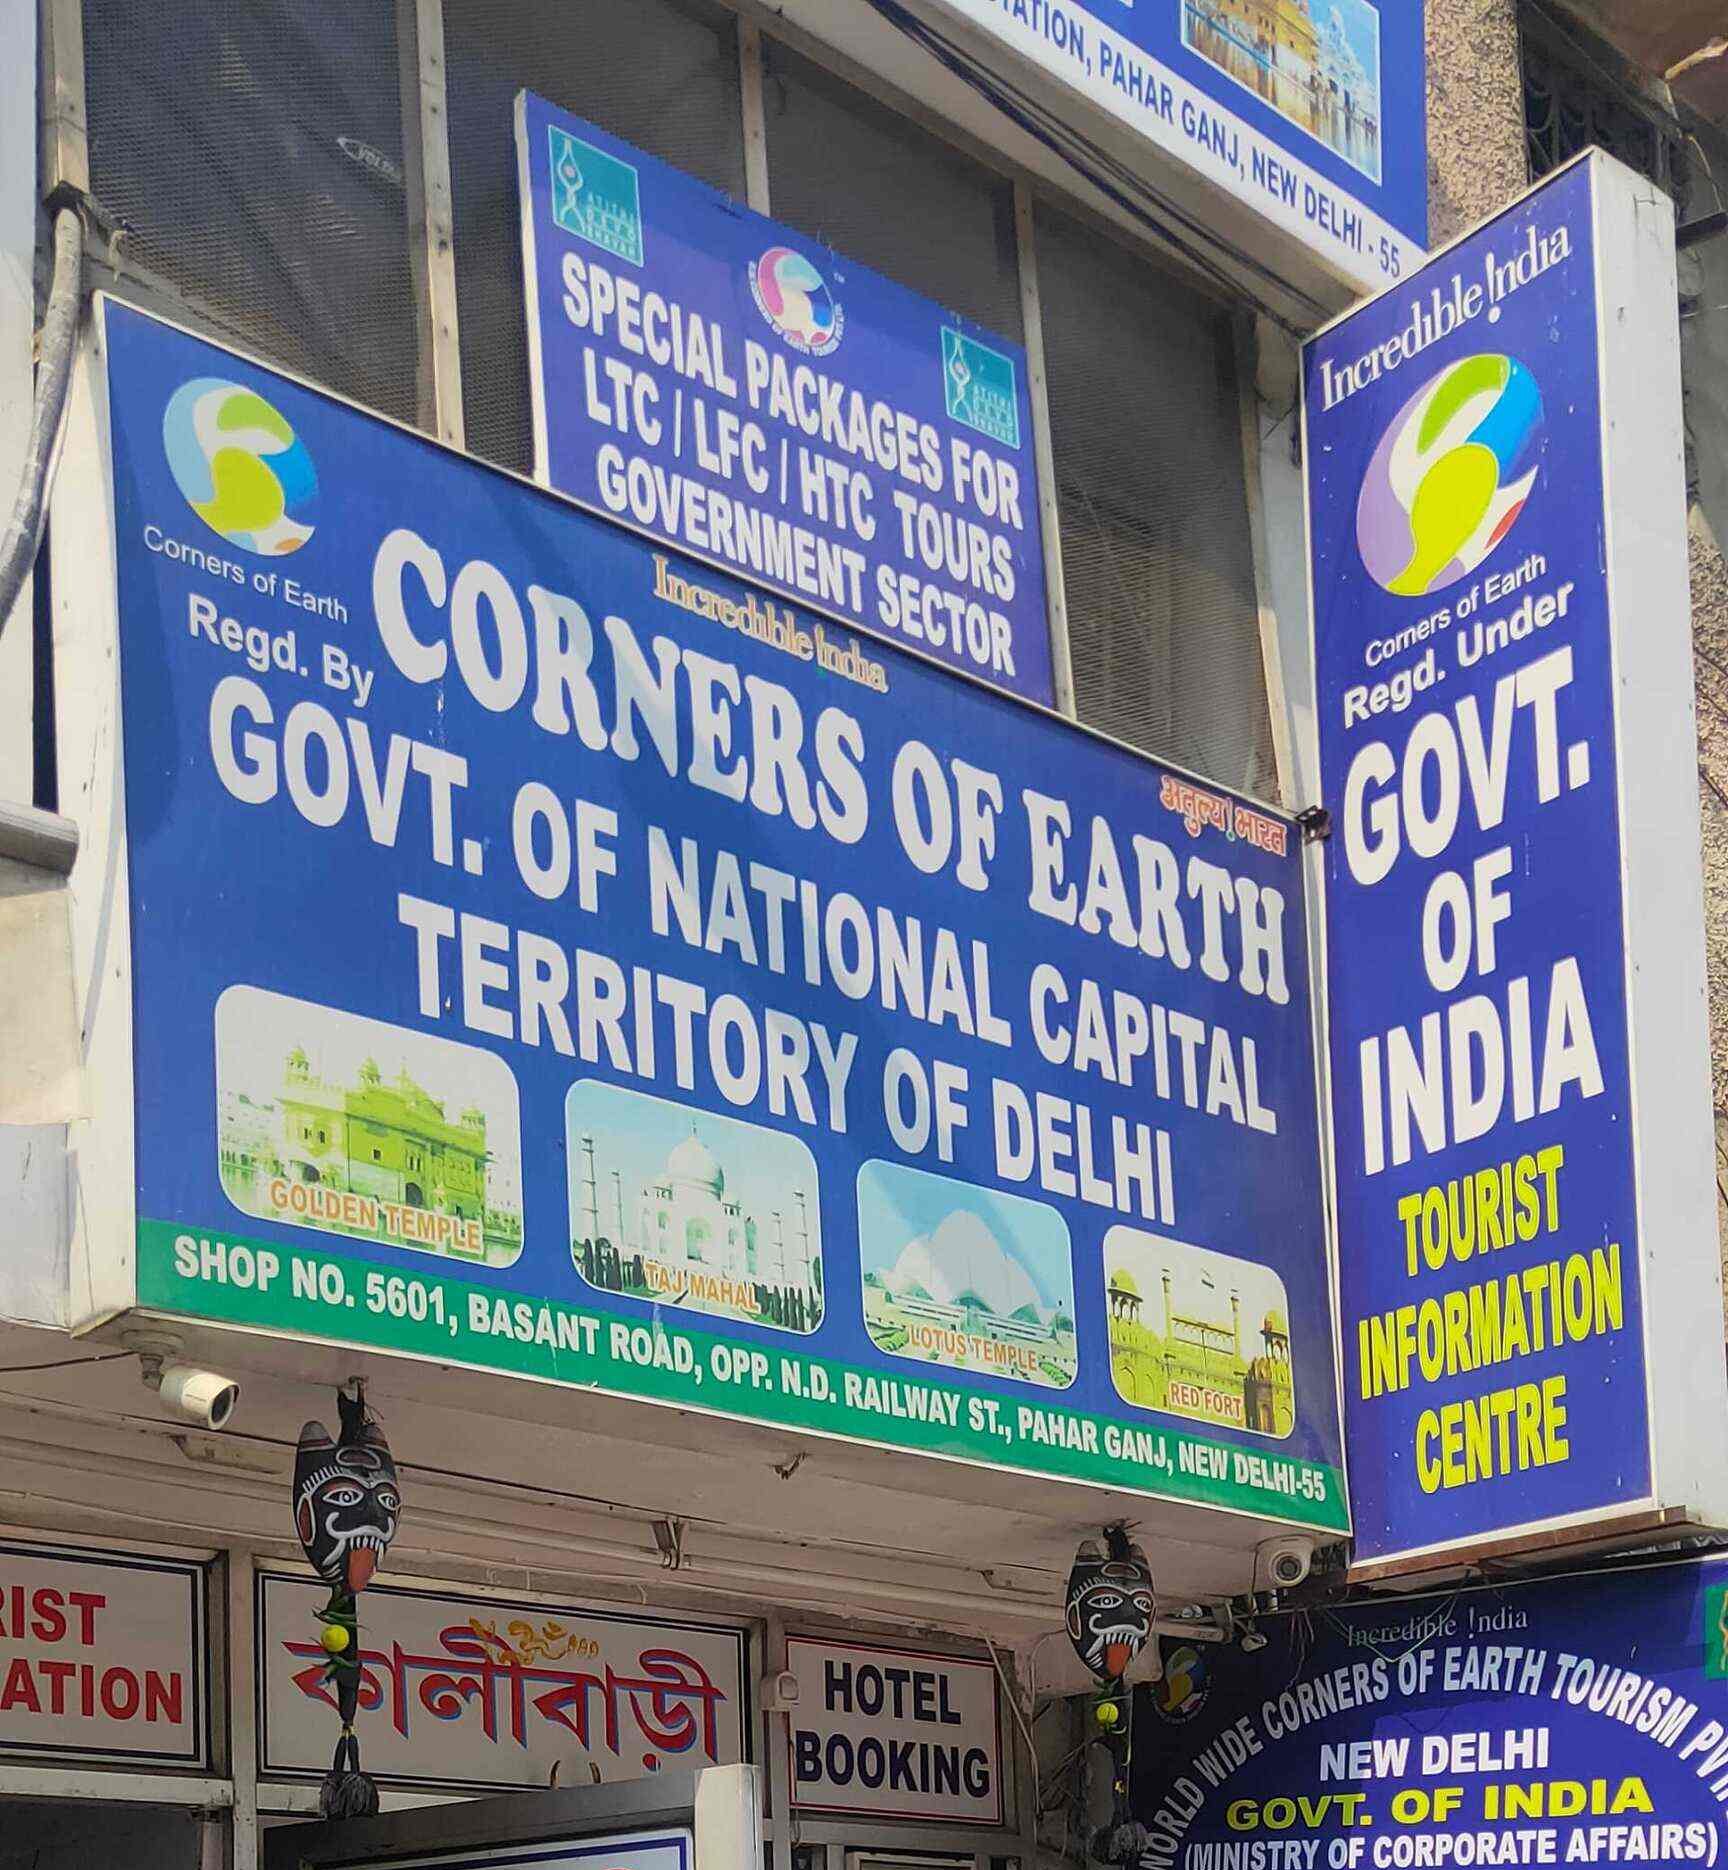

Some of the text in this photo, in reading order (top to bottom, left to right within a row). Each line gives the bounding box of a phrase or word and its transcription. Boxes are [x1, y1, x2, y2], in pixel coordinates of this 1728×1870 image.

[1099, 39, 1401, 278] PAHAR GANJ, NEW DELHI 55
[562, 251, 737, 399] SPECIAL
[745, 339, 943, 493] PACKAGES
[950, 437, 1023, 531] FOR
[1320, 273, 1483, 413] Incredible
[582, 346, 1015, 602] LTC LFC HTC TOURS
[144, 525, 348, 624] Corners of Earth
[597, 443, 1016, 678] GOVERNMENT SECTOR
[1365, 553, 1546, 668] Corners of Earth
[188, 593, 374, 708] Regd. By
[1343, 581, 1575, 729] Regd. Under
[373, 529, 1290, 1004] CORNERS OF EARTH
[1343, 645, 1592, 886] GOVT.
[209, 675, 1277, 1134] GOVT. OF NATIONAL CAPITAL
[1422, 846, 1513, 994] OF
[397, 893, 1175, 1226] TERRITORY OF DELHI
[1360, 956, 1606, 1178] INDIA
[270, 1178, 485, 1255] GOLDEN TEMPLE
[1398, 1145, 1565, 1277] TOURIST
[644, 1259, 761, 1313] TAJ MAHAL
[908, 1324, 1038, 1372] LOTUS TEMPLE
[1357, 1243, 1624, 1401] INFORMATION
[175, 1235, 1327, 1503] SHOP NO. 5601, BASANT ROAD, OPP. N.D. RAILWAY ST., PAHAR GANJ, NEW DELHI-55
[1169, 1381, 1244, 1420] RED FORT
[1414, 1375, 1571, 1495] CENTRE
[824, 1659, 962, 1726] HOTEL
[1192, 1716, 1264, 1789] WIDE
[1262, 1656, 1390, 1740] CORNERS
[1398, 1648, 1436, 1697] OF
[1443, 1645, 1547, 1696] EARTH
[1551, 1652, 1698, 1749] TOURISM
[1320, 1727, 1549, 1782] NEW DELHI
[795, 1730, 991, 1799] BOOKING
[1226, 1776, 1655, 1832] GOVT. OF INDIA
[1327, 1836, 1365, 1870] OF
[1372, 1828, 1558, 1870] CORPORATE
[1565, 1821, 1719, 1869] AFFAIRS)
